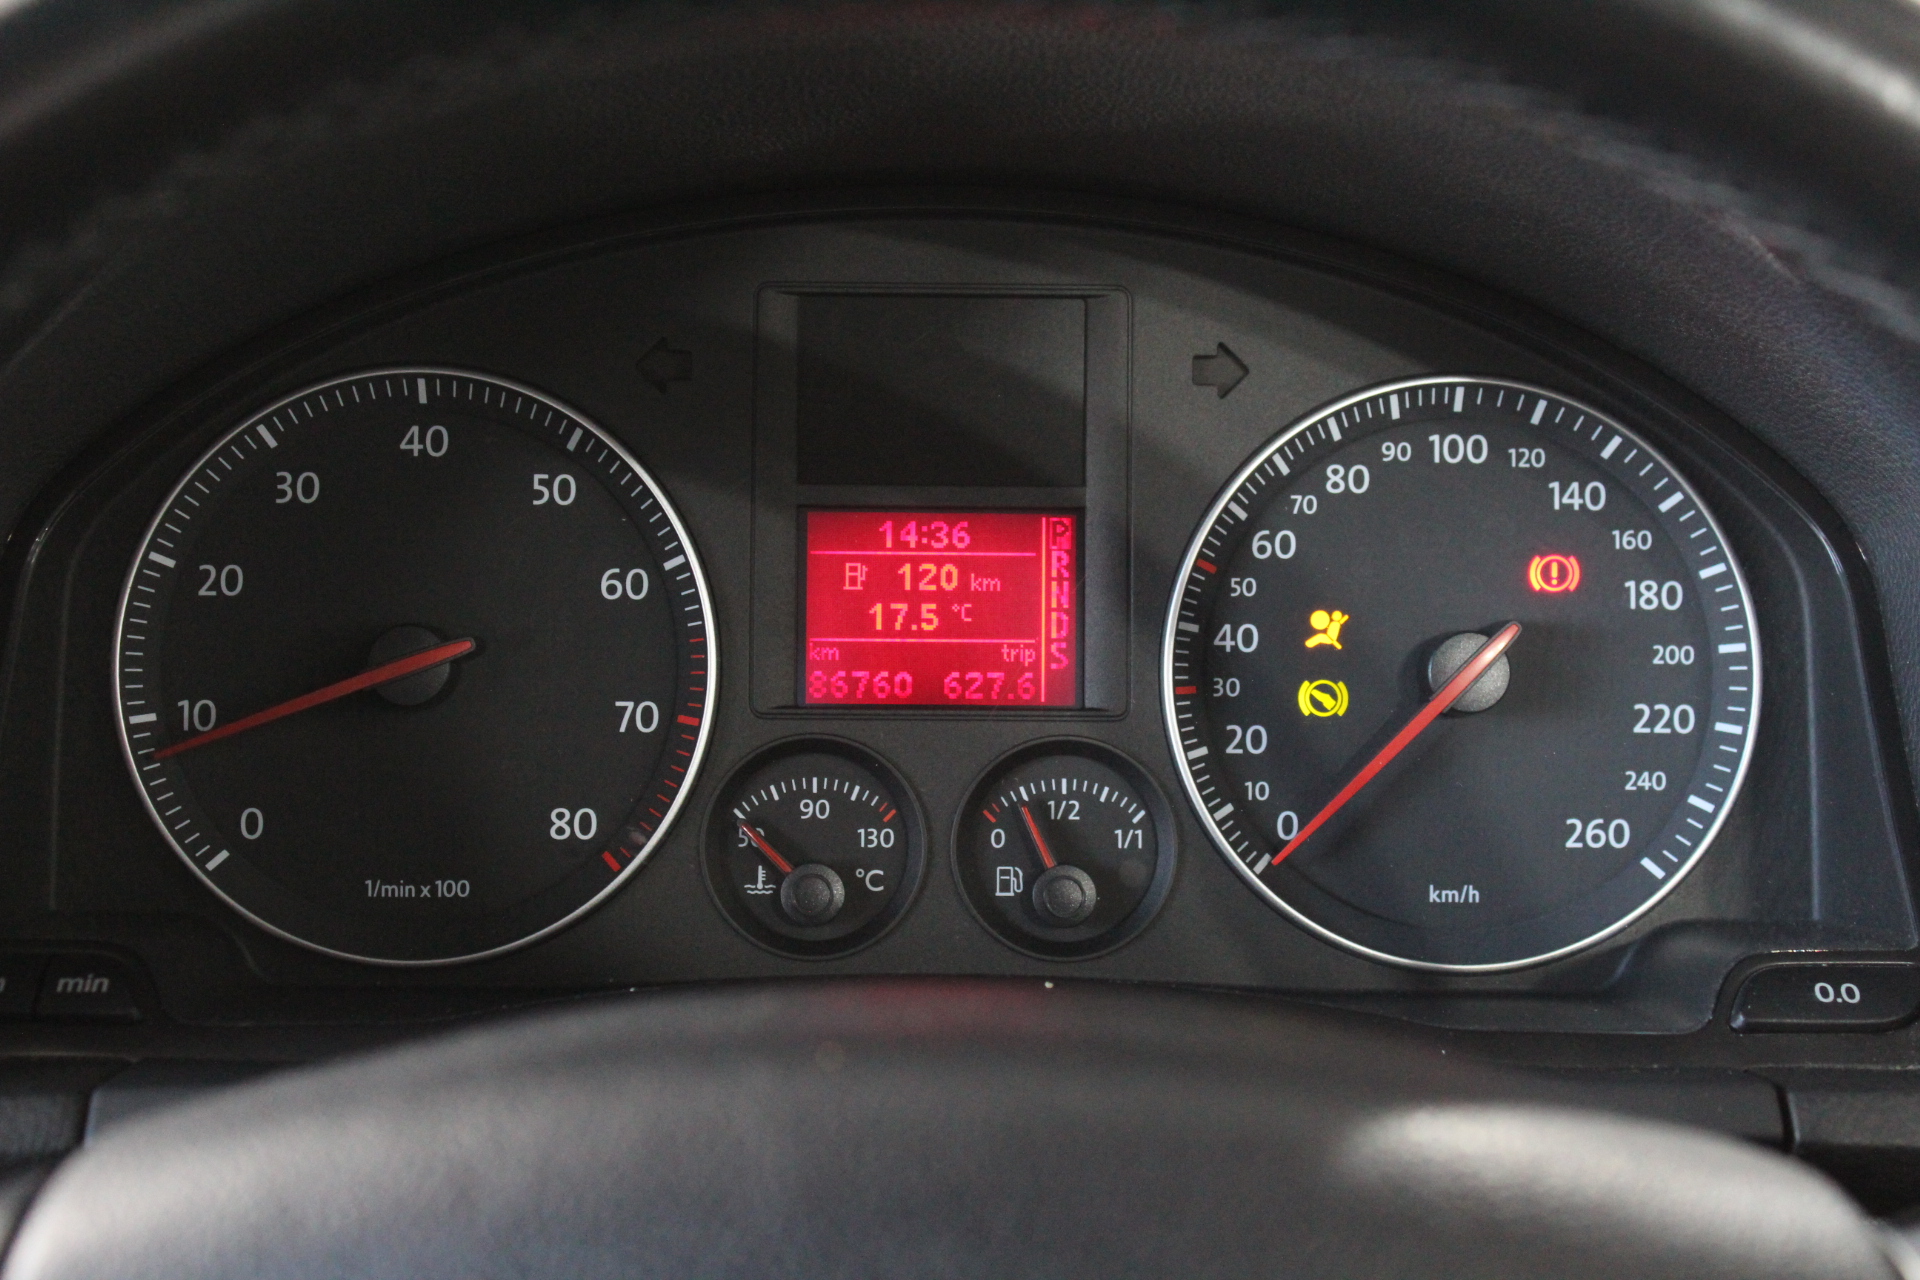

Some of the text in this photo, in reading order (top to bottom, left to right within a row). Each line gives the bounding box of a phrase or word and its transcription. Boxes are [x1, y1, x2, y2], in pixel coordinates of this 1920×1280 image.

[399, 424, 450, 458] 40
[1381, 442, 1412, 464] 90
[1428, 434, 1489, 465] 100
[1508, 447, 1546, 468] 120
[274, 470, 321, 504] 30
[531, 473, 577, 507] 50
[1325, 464, 1370, 495] 80
[1290, 494, 1318, 515] 70
[1549, 481, 1606, 512] 140
[879, 521, 970, 549] 14:36
[1251, 530, 1297, 561] 60
[1612, 530, 1653, 551] 160
[197, 563, 244, 597] 20
[600, 568, 649, 601] 60
[898, 563, 1001, 591] 120 km
[1229, 576, 1257, 598] 50
[1624, 580, 1683, 612] 180
[869, 603, 939, 631] 17.5
[808, 641, 839, 661] km
[1213, 623, 1259, 654] 40
[1001, 643, 1036, 667] trip
[1652, 645, 1695, 666] 200
[808, 670, 913, 699] 86760
[943, 672, 1035, 700] 627.6
[1212, 677, 1241, 698] 30
[177, 698, 217, 731] 10
[614, 700, 660, 734] 70
[1633, 703, 1695, 735] 220
[1225, 725, 1268, 756] 20
[1245, 781, 1270, 802] 10
[1624, 771, 1667, 792] 240
[239, 806, 264, 841] 0
[549, 807, 598, 841] 80
[799, 800, 830, 820] 90
[1048, 800, 1080, 821] 1/2
[857, 829, 895, 848] 130
[990, 829, 1006, 849] 0
[1115, 829, 1144, 849] 1/1
[1276, 811, 1299, 843] 0
[1564, 819, 1631, 850] 260
[364, 878, 470, 899] 1/min x 100
[1428, 884, 1481, 904] km/h
[56, 973, 109, 993] min
[1814, 982, 1861, 1004] 0.0
